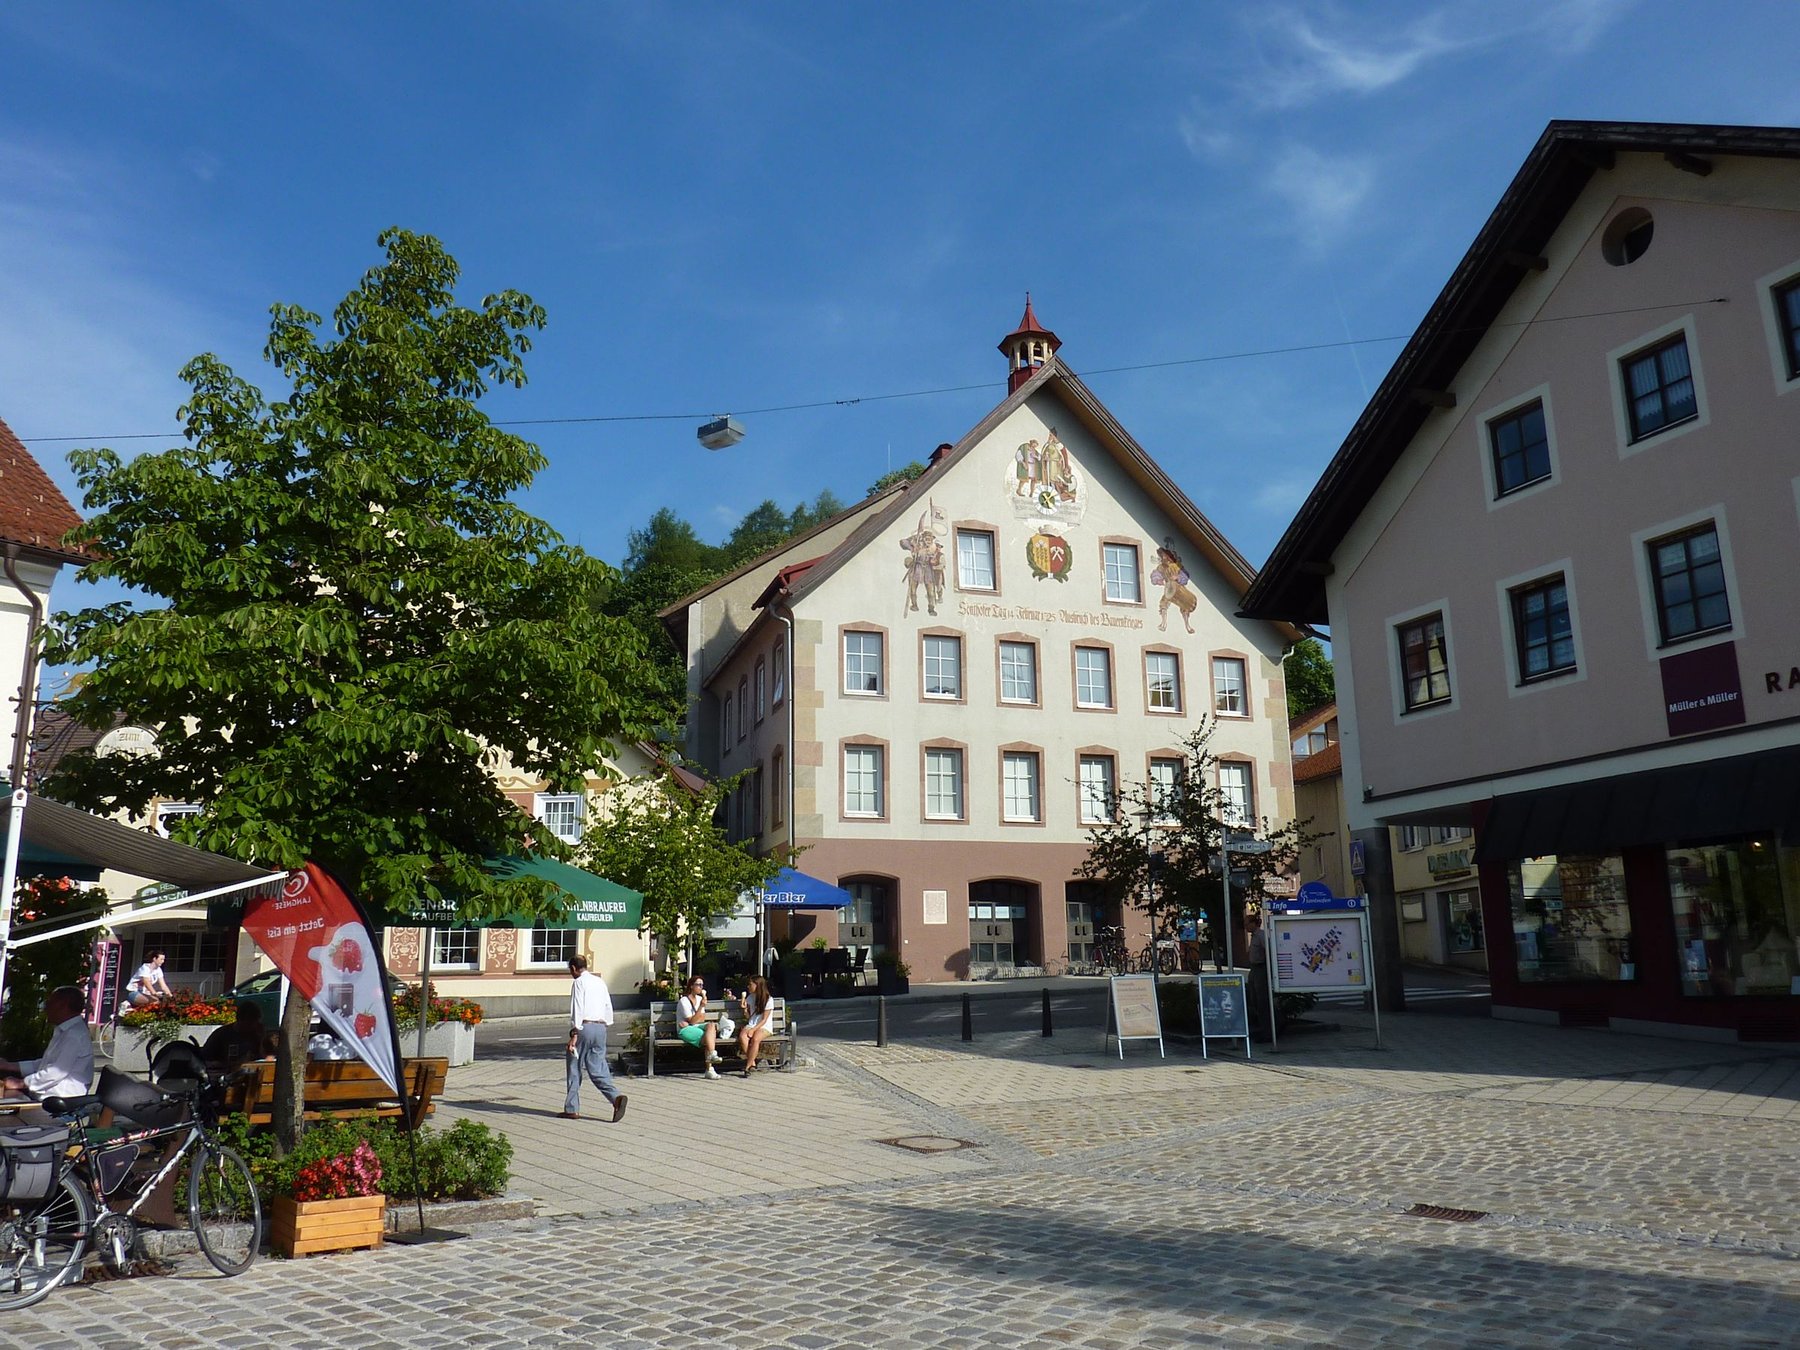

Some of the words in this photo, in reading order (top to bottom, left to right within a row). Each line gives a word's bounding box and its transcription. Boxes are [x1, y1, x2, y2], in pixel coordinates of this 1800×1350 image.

[1669, 700, 1699, 713] Müller
[1699, 699, 1706, 707] &
[1707, 692, 1738, 705] Müller
[778, 892, 806, 903] Bier
[1272, 902, 1288, 910] Info
